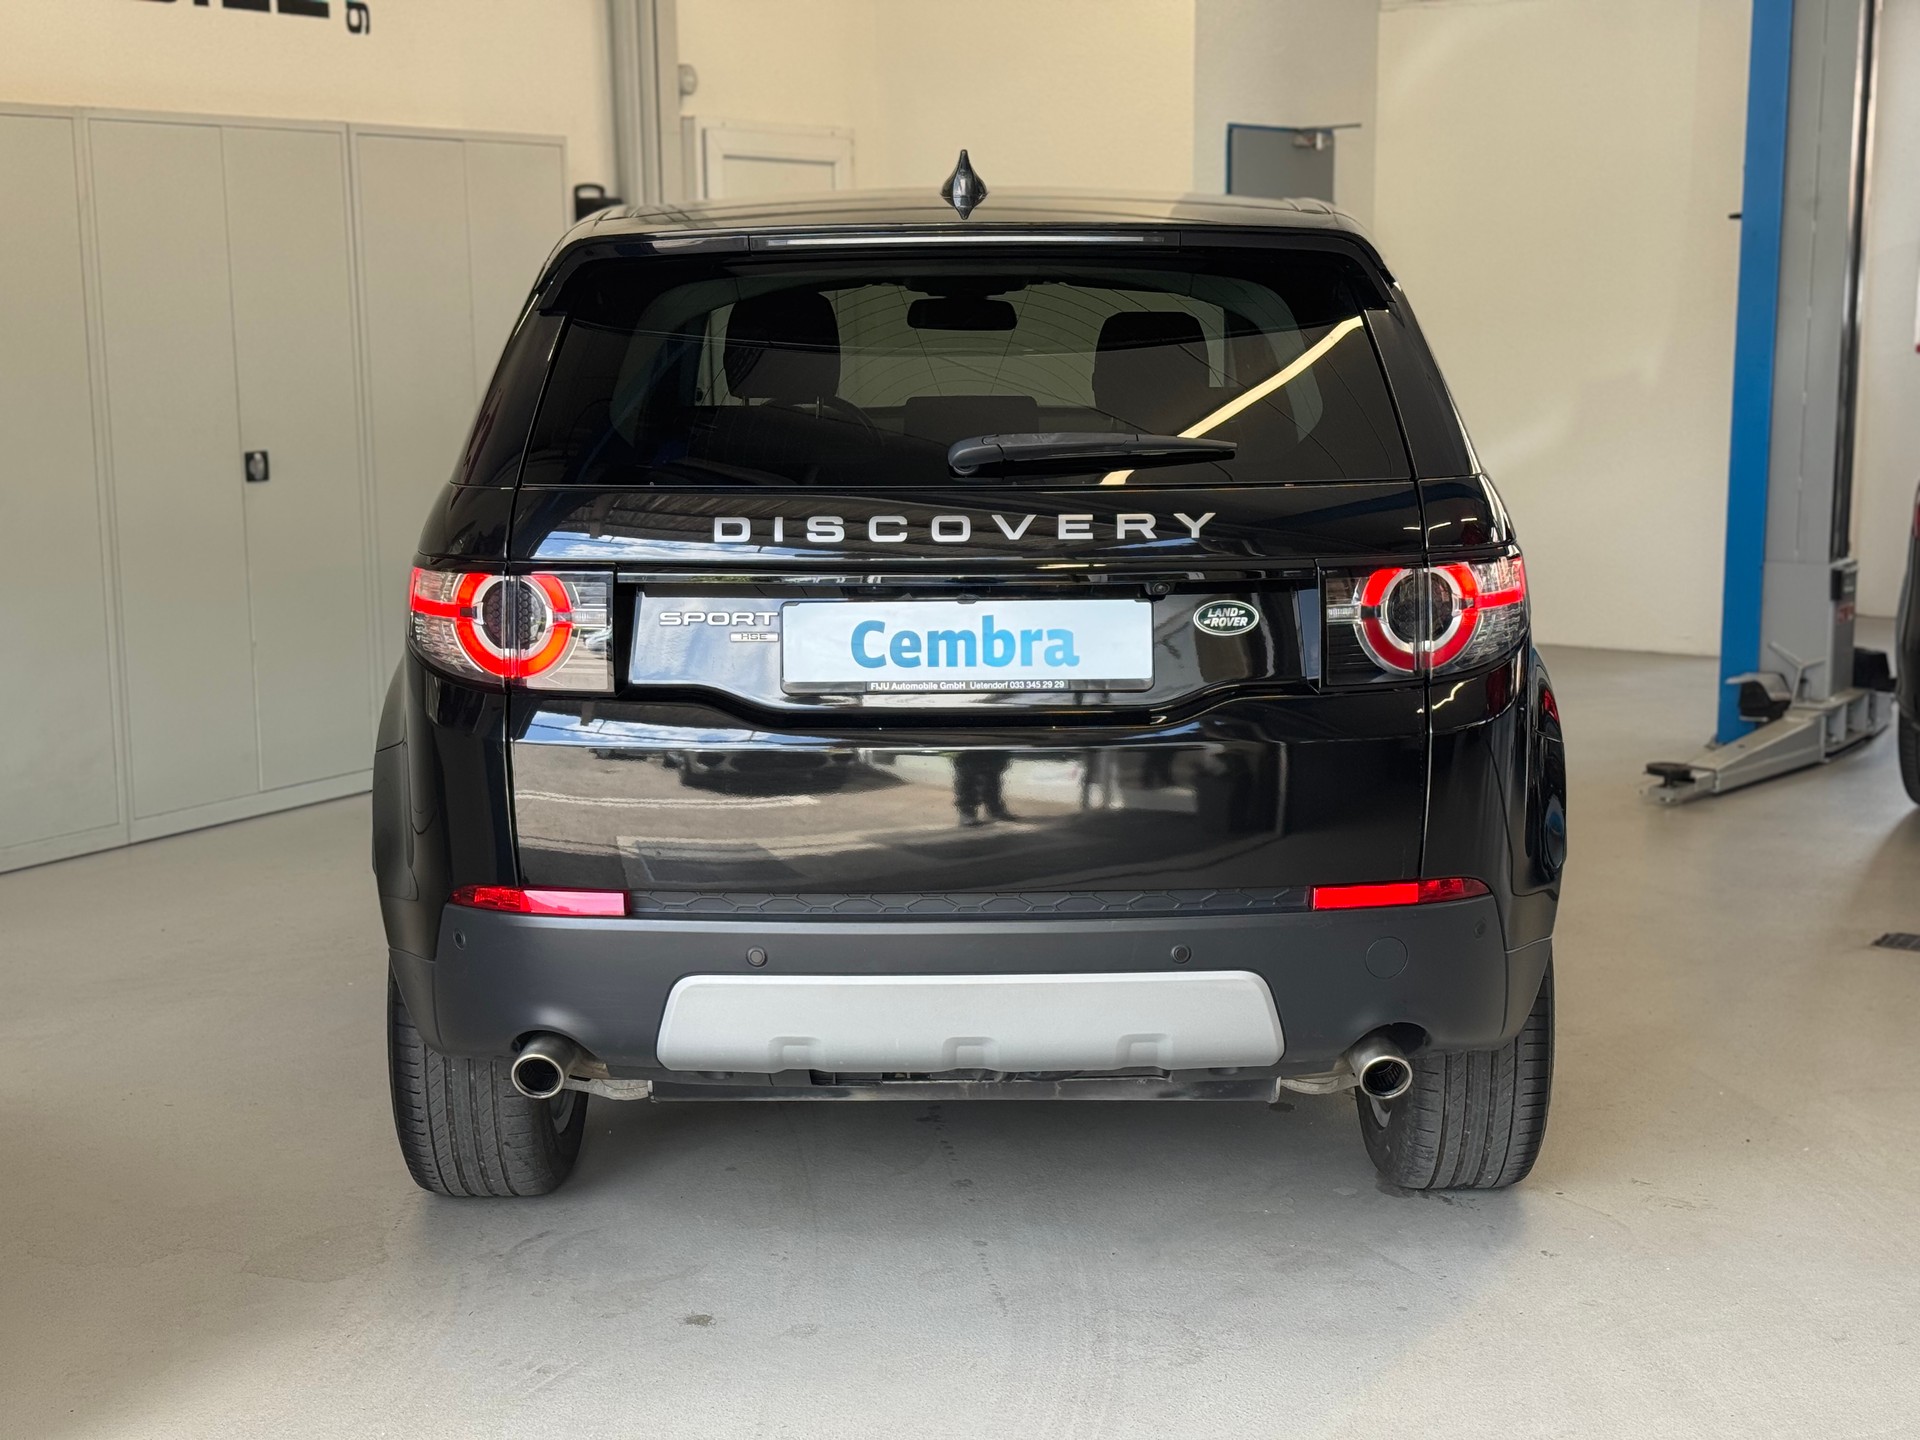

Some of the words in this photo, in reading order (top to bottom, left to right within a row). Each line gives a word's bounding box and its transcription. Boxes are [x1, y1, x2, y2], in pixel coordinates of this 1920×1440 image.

[713, 512, 1217, 543] DISCOVERY
[659, 611, 779, 627] SPORT
[740, 632, 768, 641] HSE
[850, 614, 1081, 669] Cembra
[891, 681, 938, 691] Automobile
[939, 681, 966, 690] GmbH
[969, 681, 1009, 690] Uetendorf
[1009, 680, 1025, 689] 033
[1026, 680, 1041, 689] 345
[1042, 680, 1053, 689] 29
[1054, 680, 1065, 689] 29
